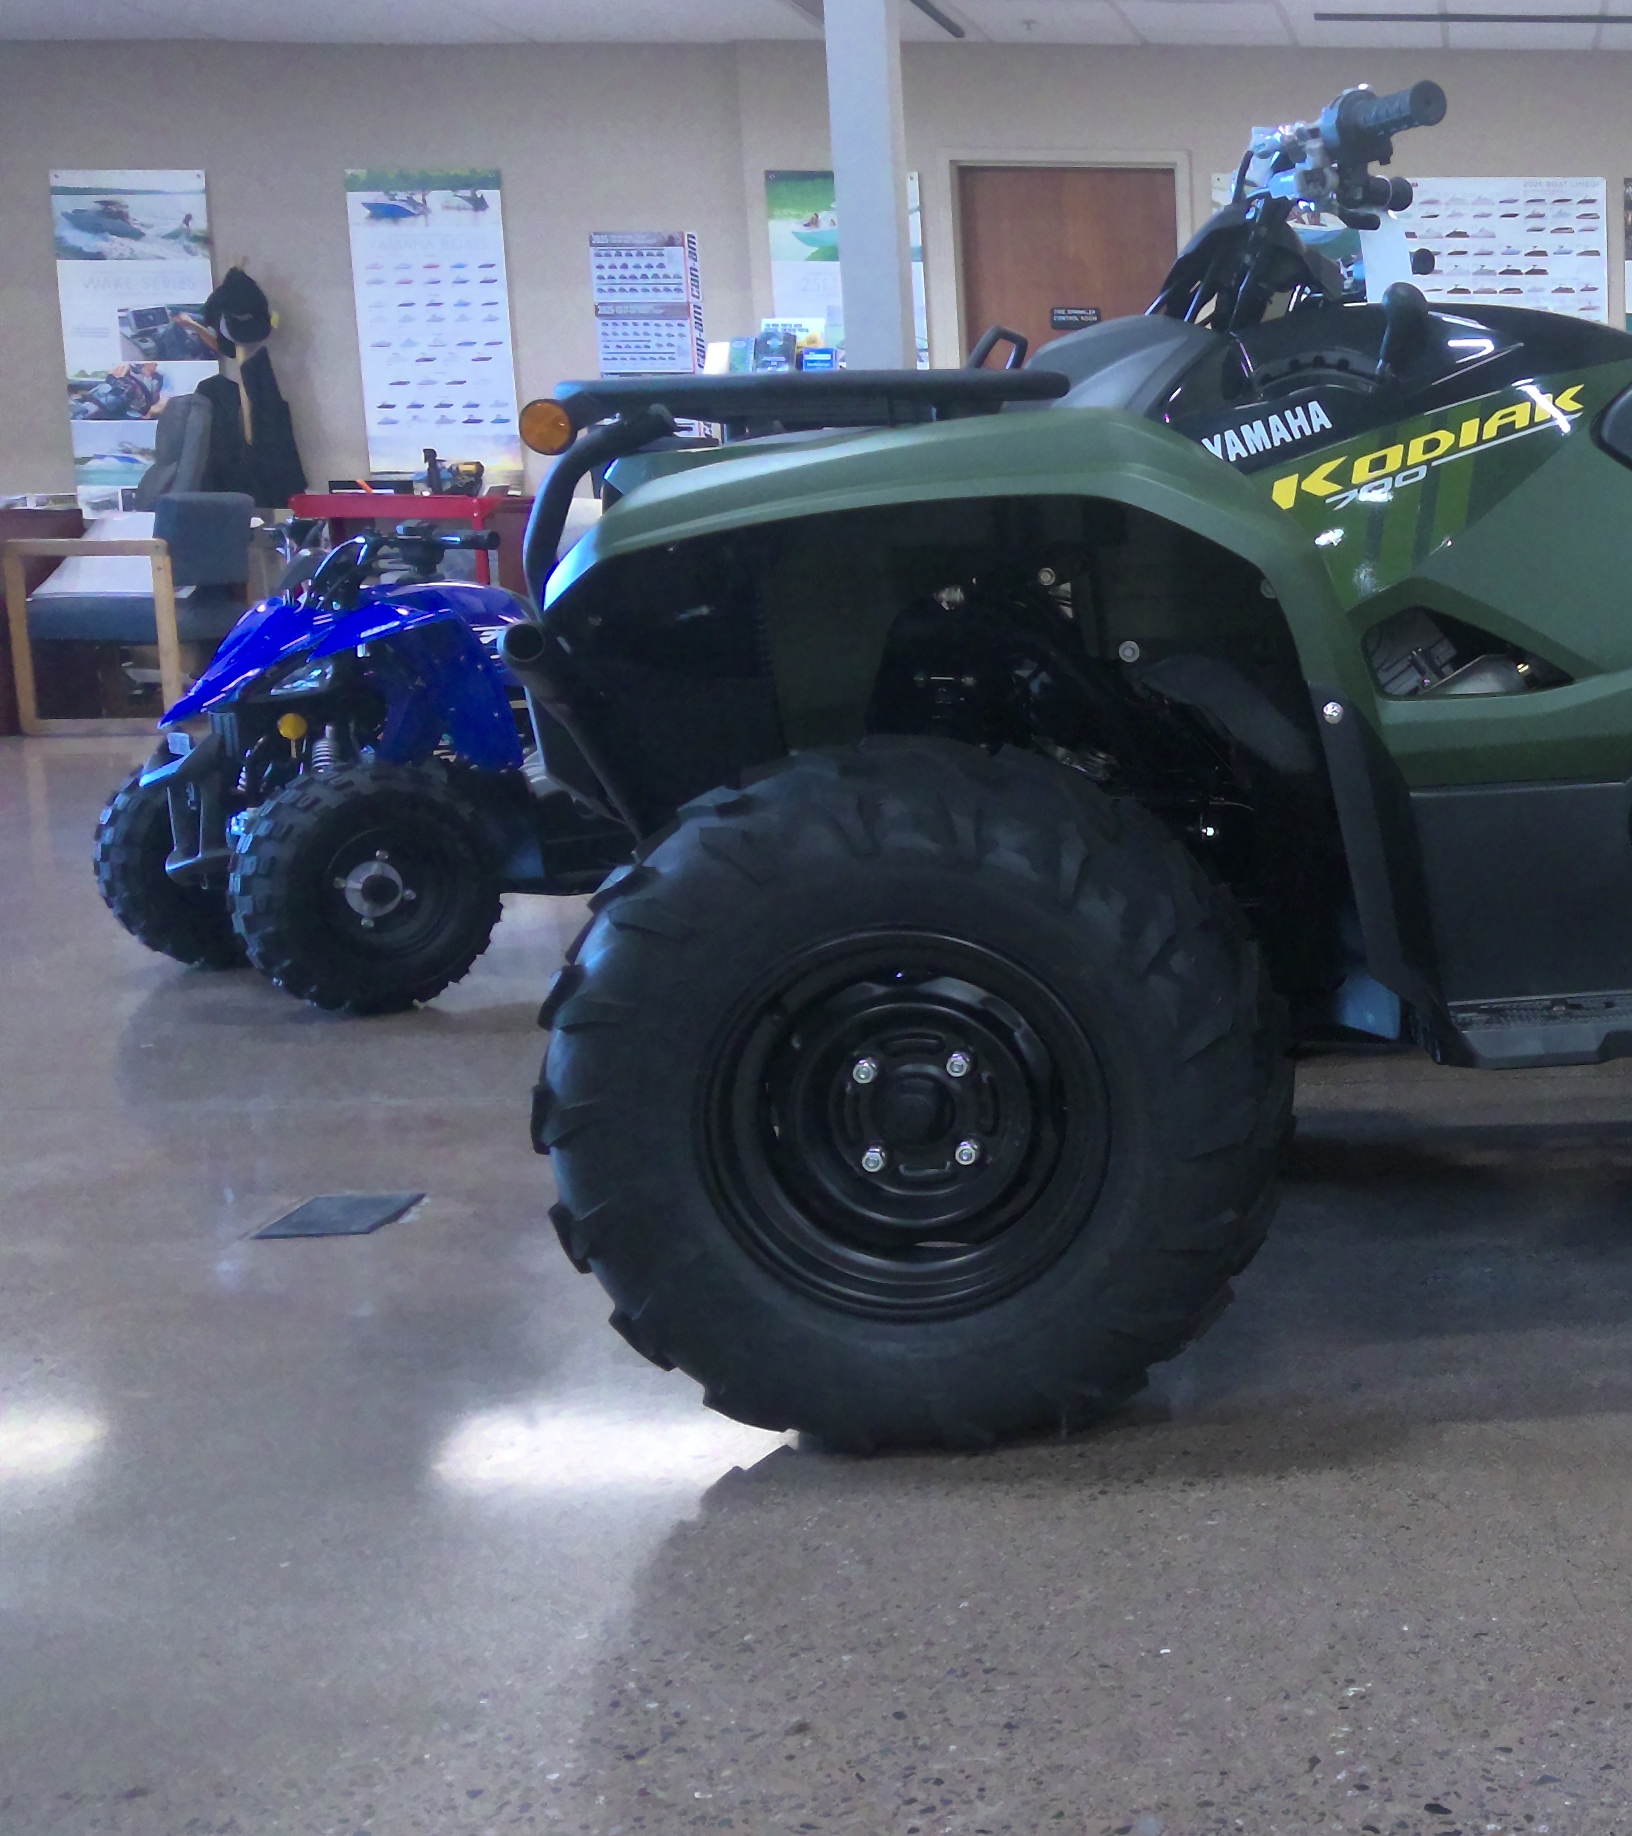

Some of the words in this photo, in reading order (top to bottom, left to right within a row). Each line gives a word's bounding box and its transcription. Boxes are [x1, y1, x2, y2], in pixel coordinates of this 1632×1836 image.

[1201, 400, 1333, 462] YAMAHA
[1271, 384, 1585, 510] KODIAK
[1325, 465, 1428, 511] 700
